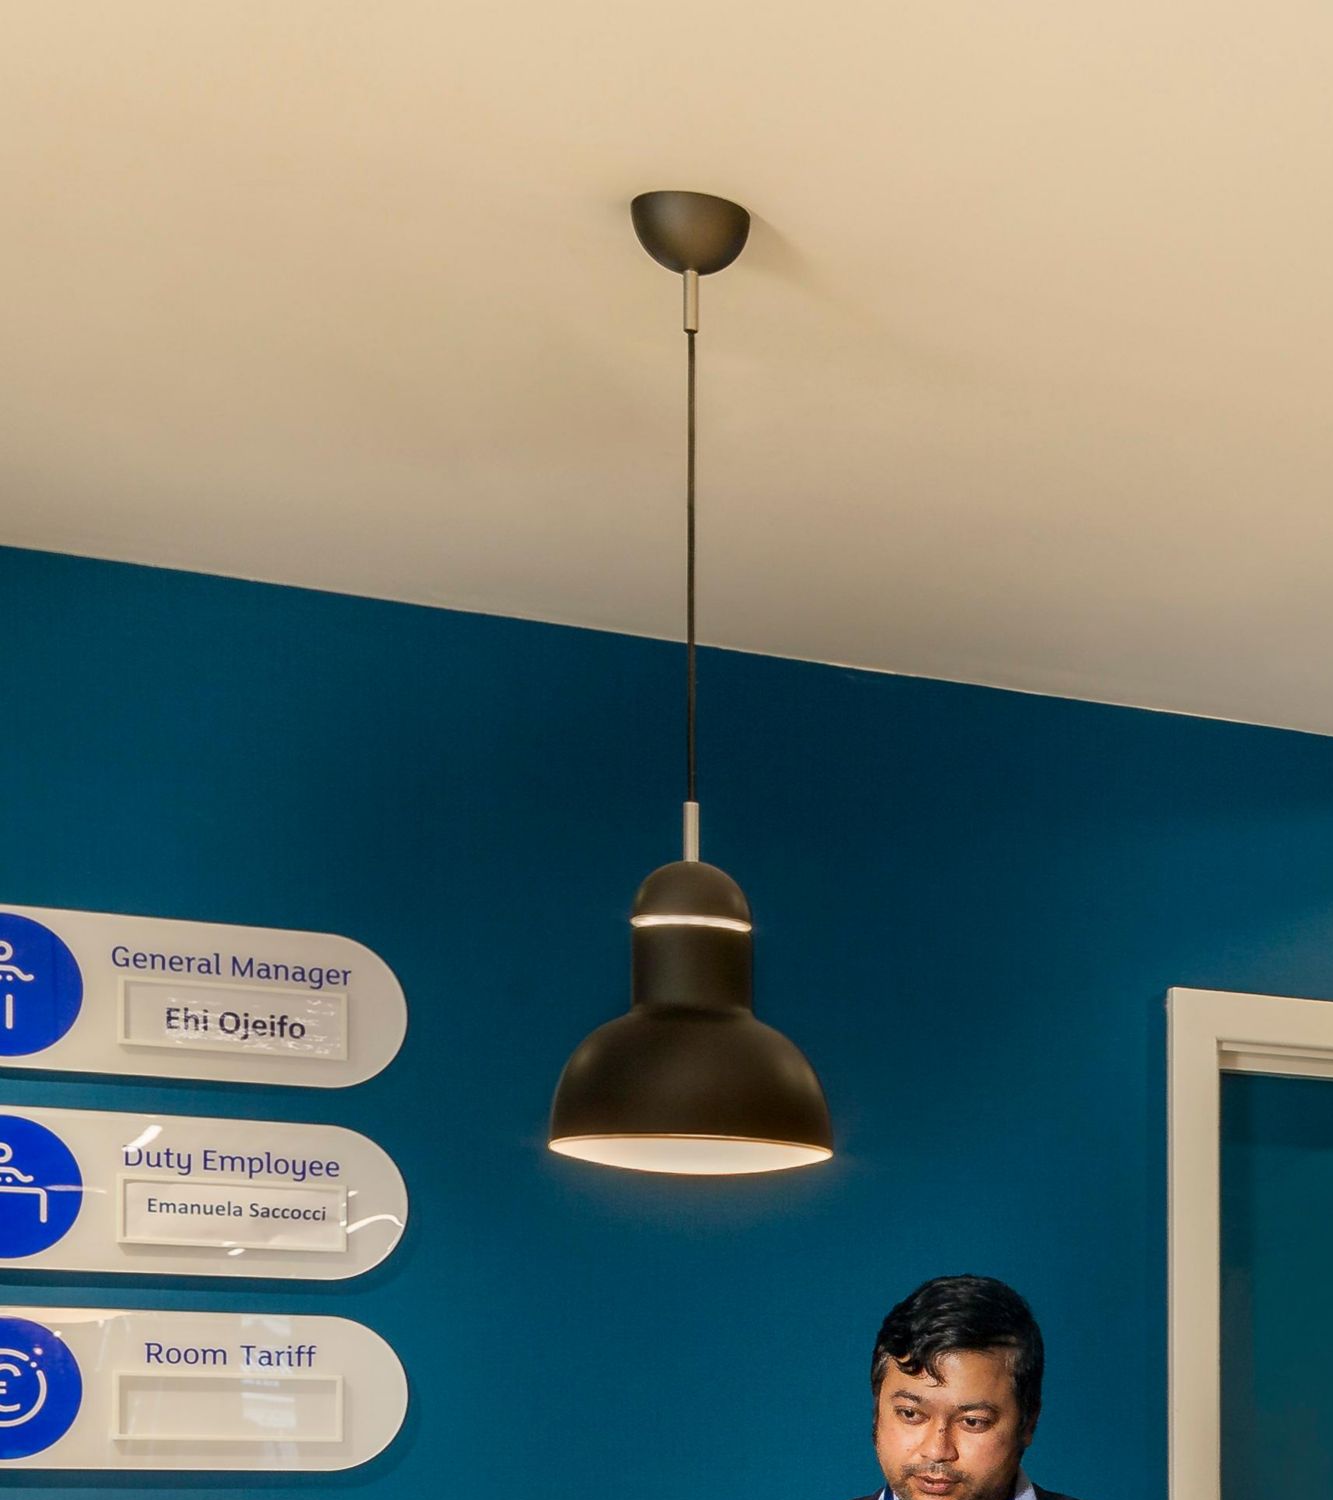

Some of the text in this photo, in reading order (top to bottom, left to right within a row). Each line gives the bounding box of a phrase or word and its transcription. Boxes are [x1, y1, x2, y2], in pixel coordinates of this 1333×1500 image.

[112, 946, 352, 989] General Manager
[166, 1007, 306, 1040] Ehi Ojeifo
[123, 1145, 341, 1182] Duty Employee
[147, 1198, 327, 1222] Emanuela Saccocci
[145, 1342, 318, 1368] Room Tariff
